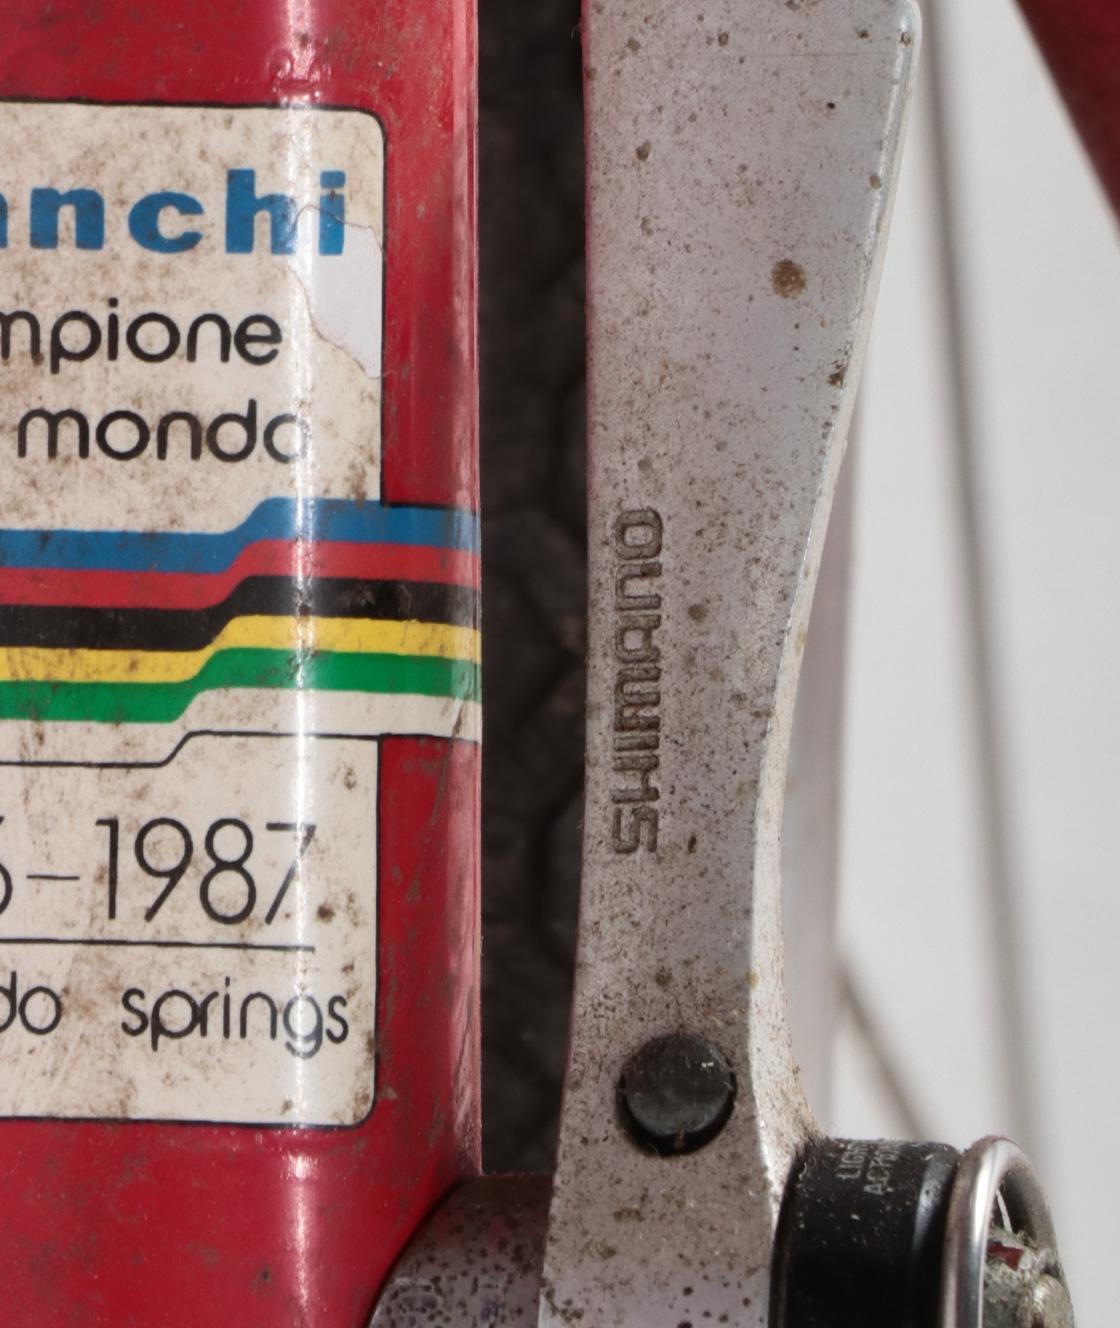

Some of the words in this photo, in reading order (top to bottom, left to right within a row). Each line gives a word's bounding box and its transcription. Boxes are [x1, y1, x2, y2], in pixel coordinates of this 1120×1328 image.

[16, 398, 312, 464] mondo
[610, 506, 664, 855] SHIMANO
[120, 977, 350, 1059] springs
